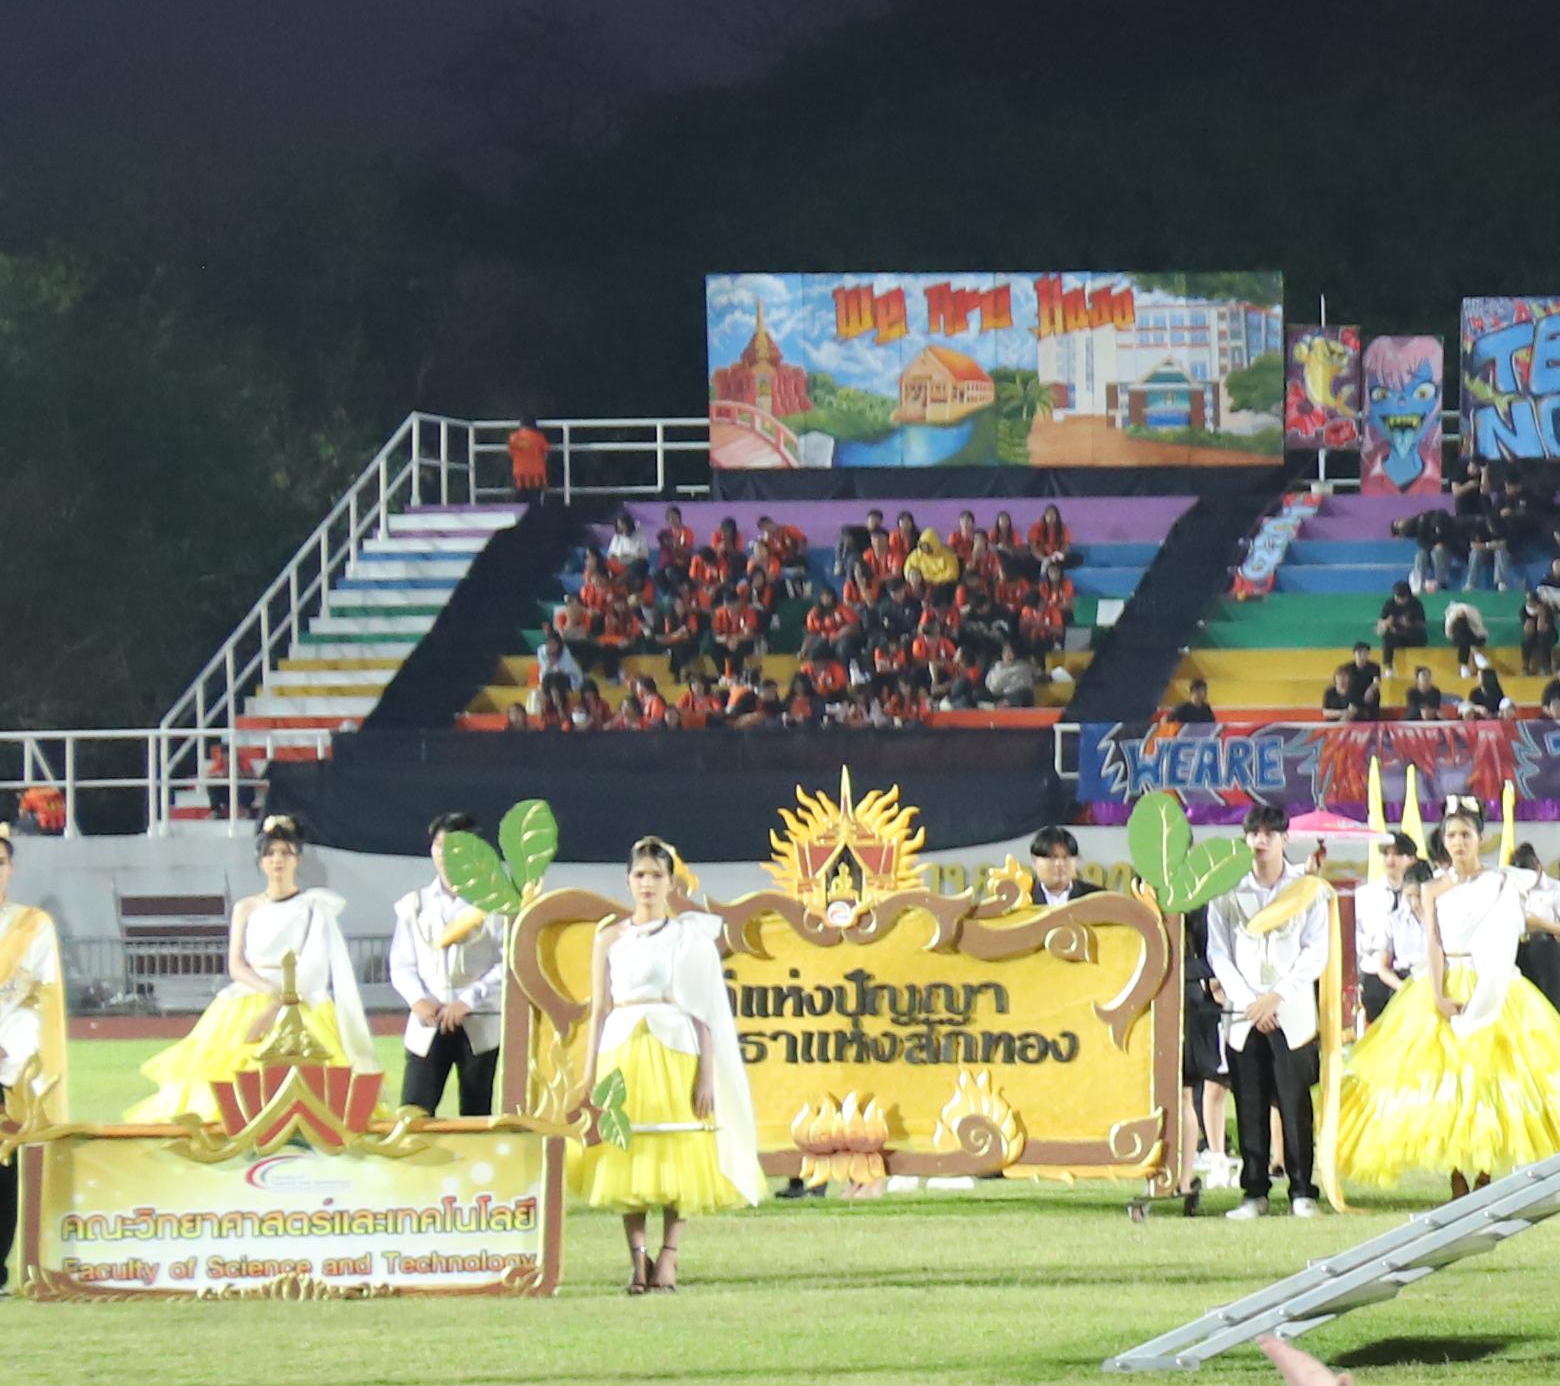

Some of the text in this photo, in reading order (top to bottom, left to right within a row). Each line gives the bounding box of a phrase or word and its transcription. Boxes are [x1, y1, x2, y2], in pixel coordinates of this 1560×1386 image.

[60, 1194, 538, 1242] คณะวิทยาศาสตร์และเทคโนโลยี
[62, 1249, 538, 1285] Faculty of Science and Technology
